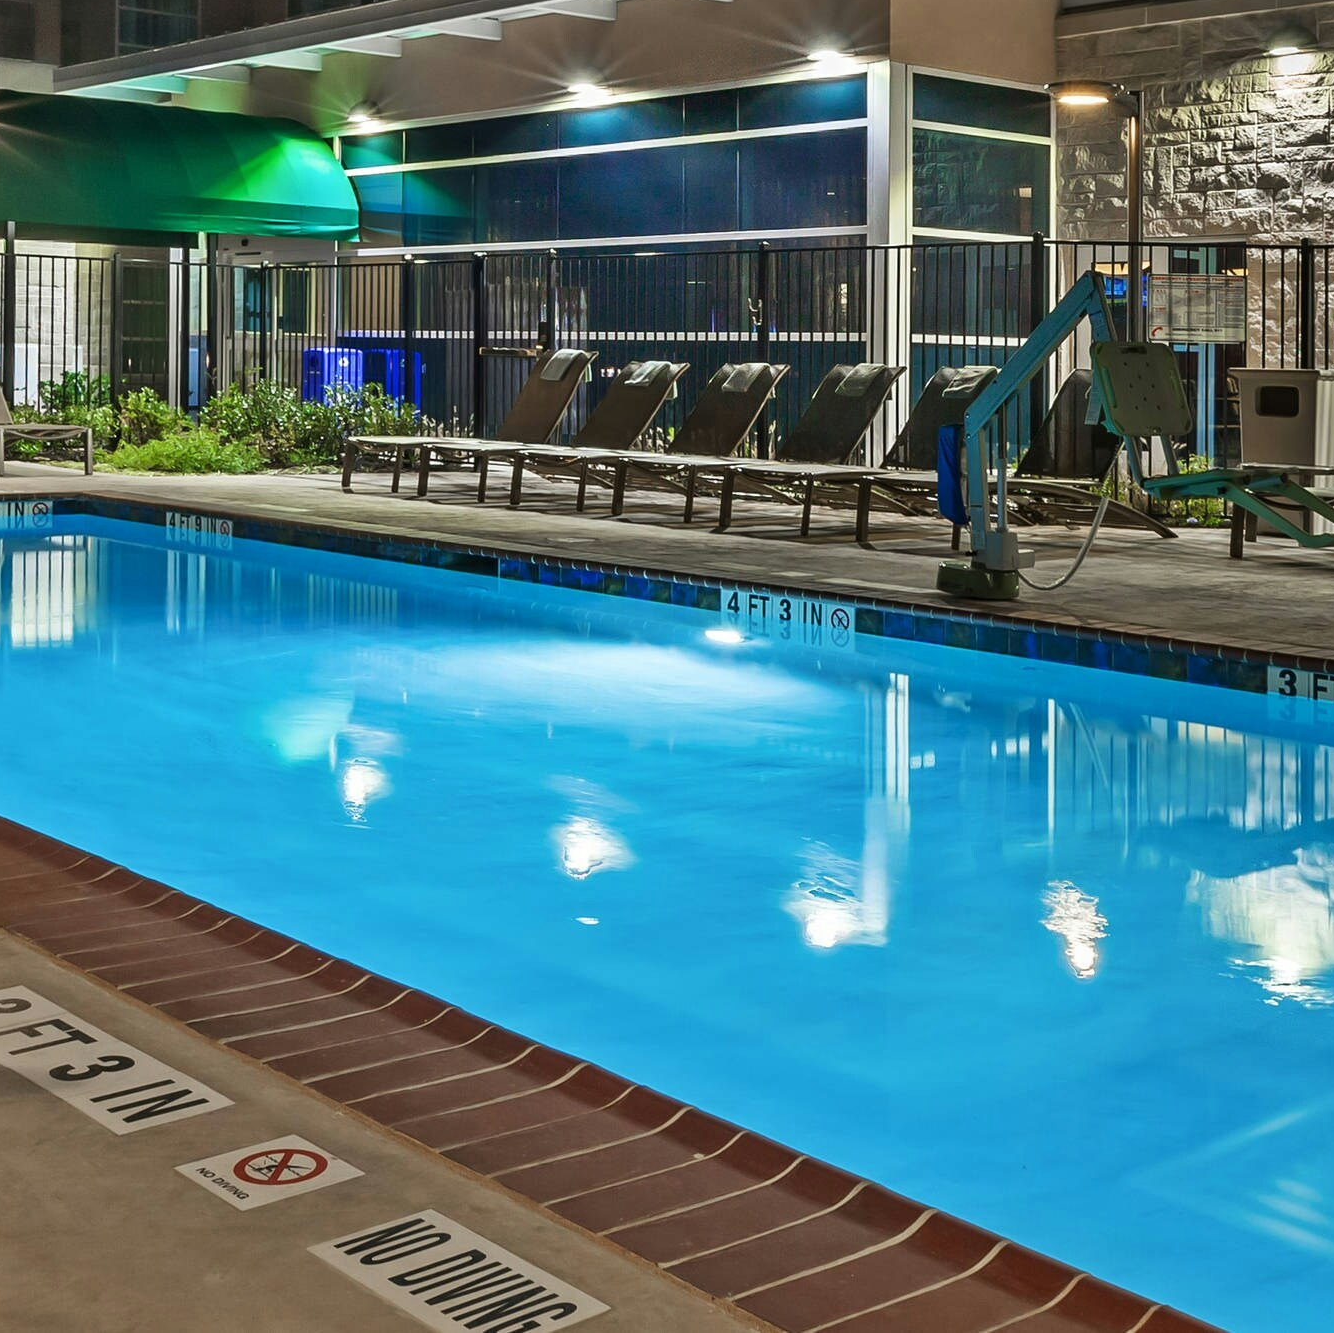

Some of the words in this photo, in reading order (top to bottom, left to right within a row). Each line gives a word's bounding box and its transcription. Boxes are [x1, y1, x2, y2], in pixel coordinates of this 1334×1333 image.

[7, 501, 25, 516] IN
[169, 512, 176, 527] 4
[180, 514, 190, 530] FT
[194, 515, 202, 532] 9
[207, 516, 217, 533] IN
[727, 592, 740, 613] 4
[748, 594, 770, 618] FT
[779, 598, 792, 621] 3
[803, 601, 823, 626] IN
[1278, 669, 1298, 697] 3
[49, 1055, 135, 1082] 3
[89, 1079, 210, 1124] IN
[196, 1167, 216, 1179] NO
[212, 1177, 249, 1200] DIVING
[333, 1218, 452, 1265] NO
[387, 1249, 578, 1333] DIVING
